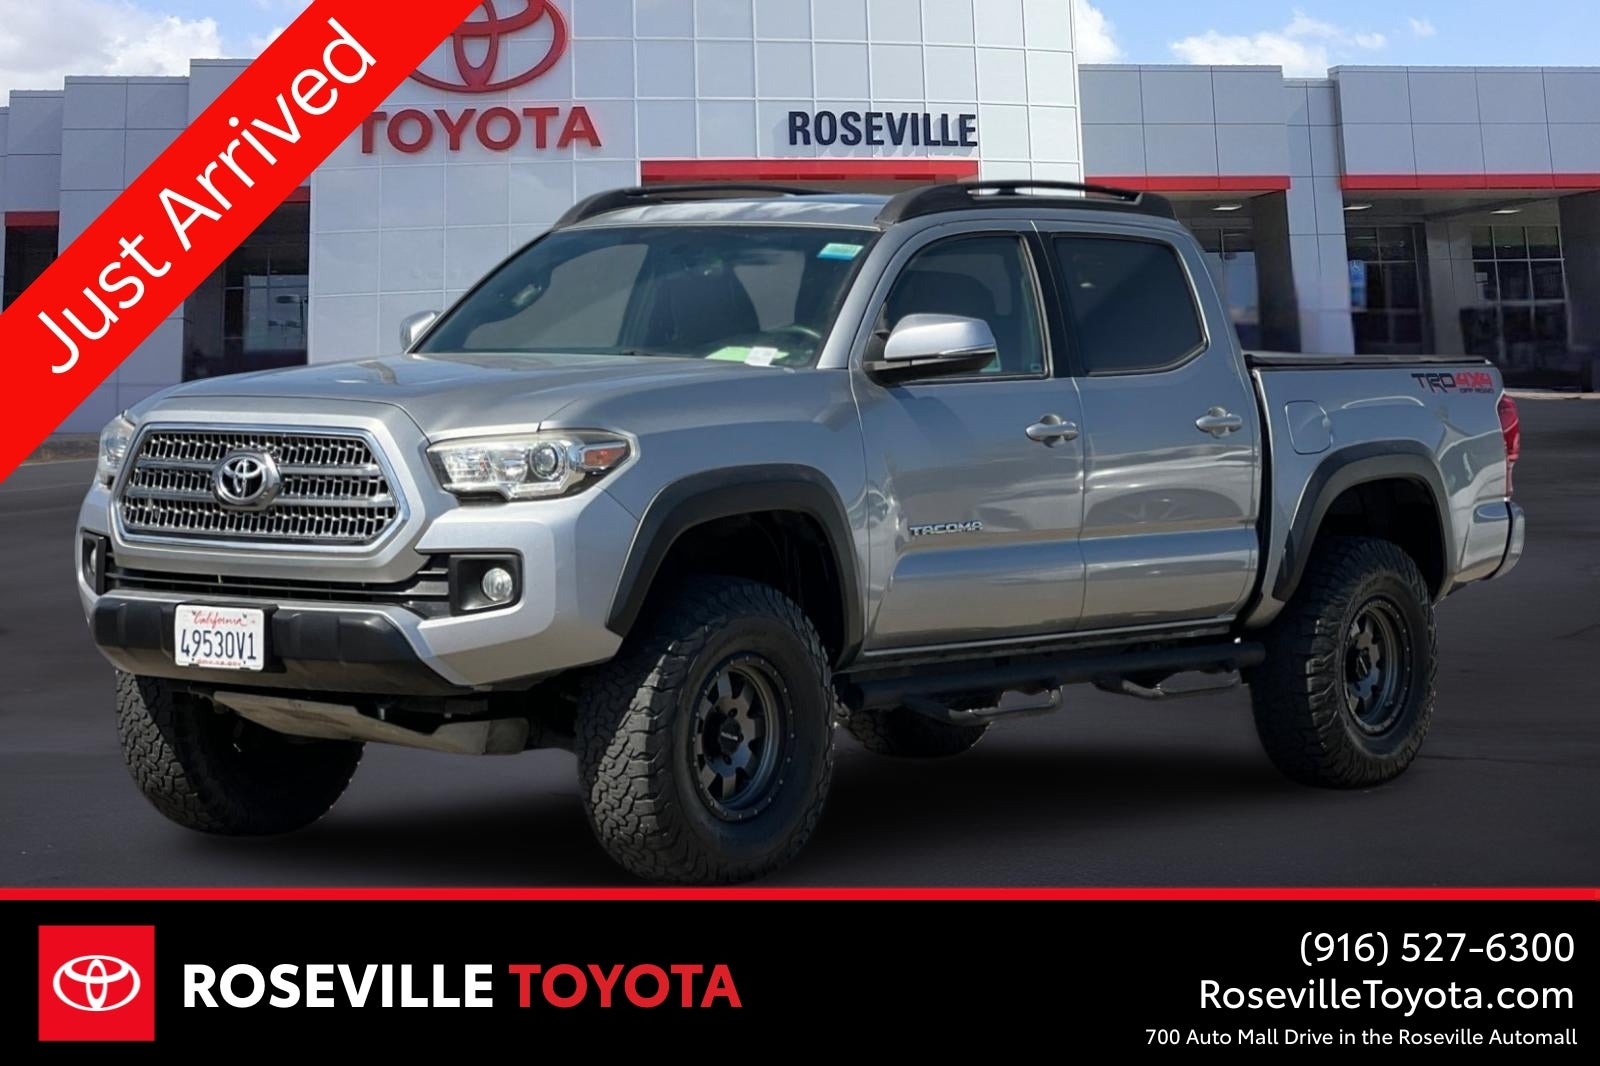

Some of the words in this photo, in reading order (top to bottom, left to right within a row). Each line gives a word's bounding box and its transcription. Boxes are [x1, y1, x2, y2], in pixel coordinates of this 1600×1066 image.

[361, 107, 602, 153] TOYOTA
[788, 110, 978, 147] ROSEVILLE
[1411, 373, 1457, 393] TRD
[910, 521, 983, 536] TACOMA
[193, 610, 248, 629] California
[180, 629, 257, 660] 49530V1
